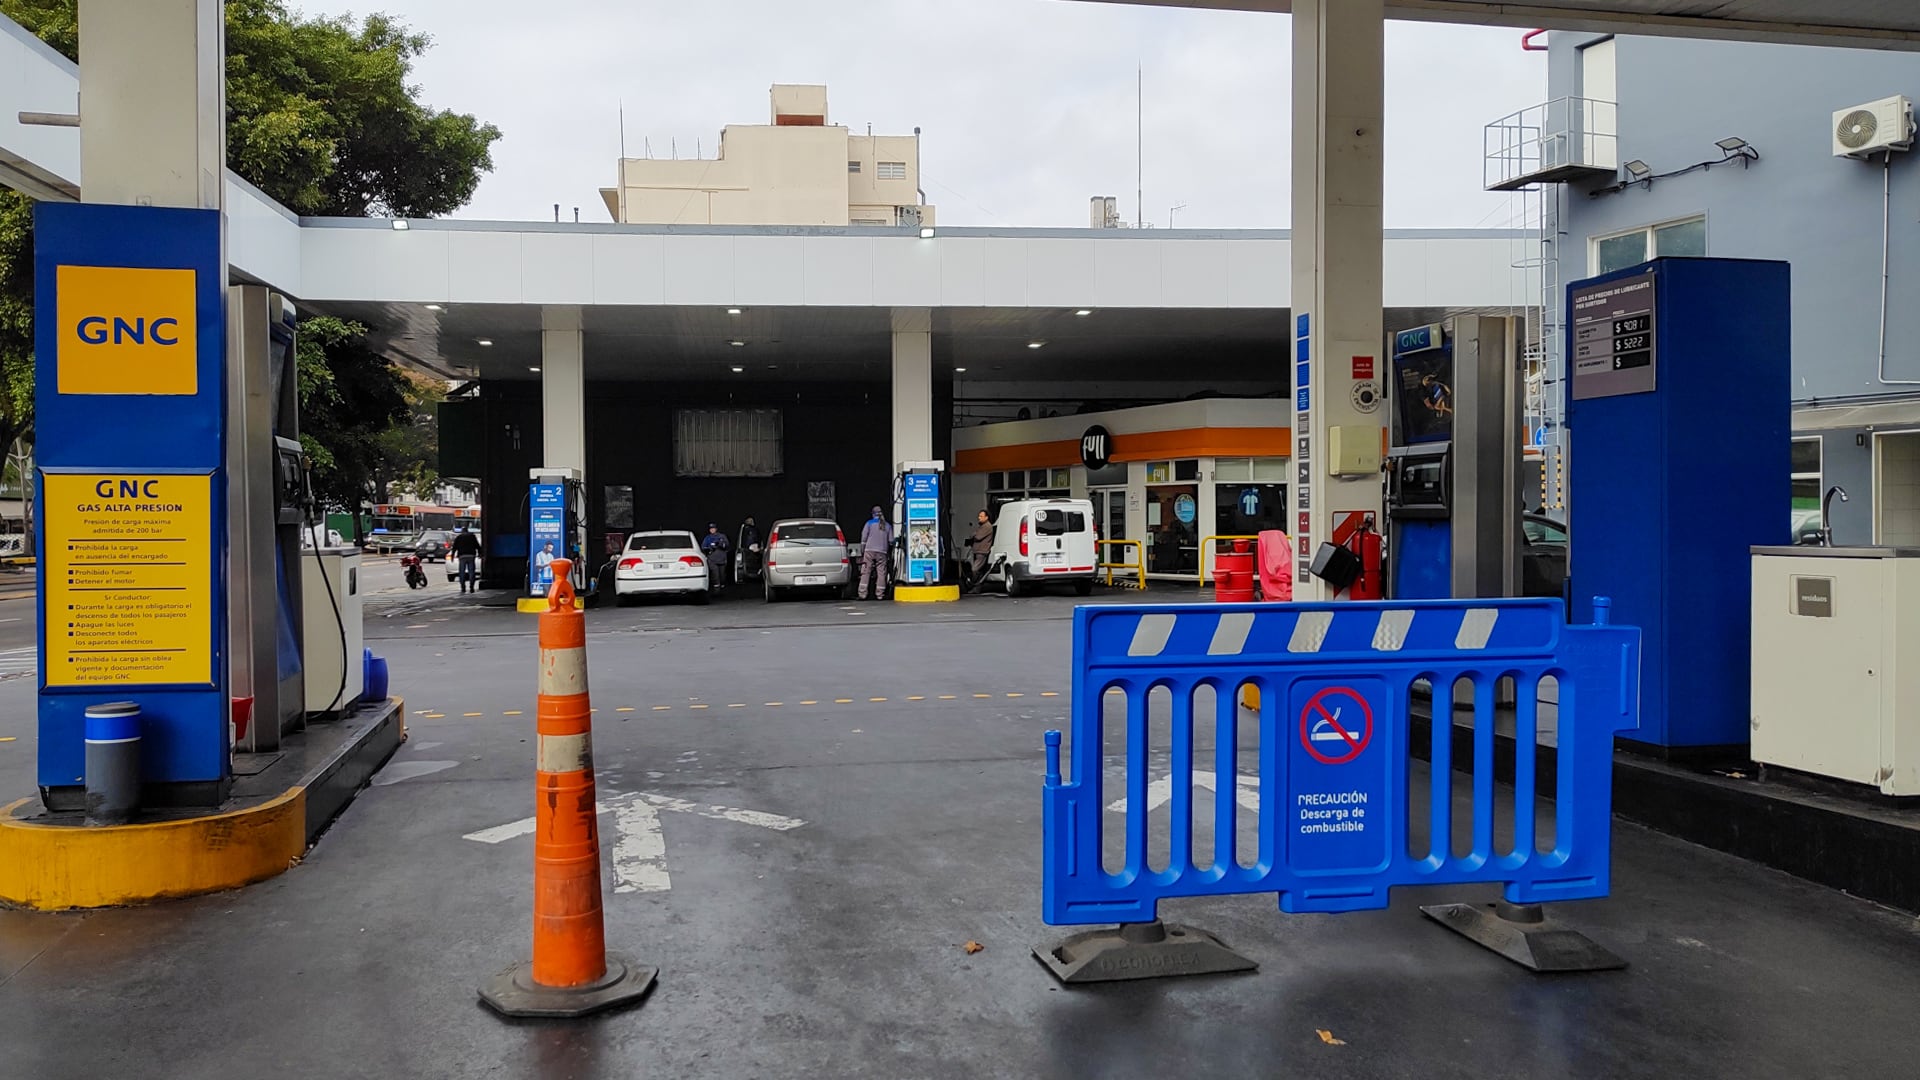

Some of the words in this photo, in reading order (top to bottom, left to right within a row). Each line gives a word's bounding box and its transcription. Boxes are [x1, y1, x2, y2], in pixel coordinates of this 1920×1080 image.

[76, 316, 178, 345] GNC
[1401, 331, 1425, 348] GNC
[1082, 434, 1105, 461] full
[908, 477, 914, 485] 3
[931, 477, 936, 485] 4
[96, 479, 160, 498] GNC
[532, 487, 536, 495] 1
[556, 487, 562, 495] 2
[78, 504, 100, 512] GAS
[135, 504, 183, 512] PRESION
[1298, 790, 1368, 806] PRECAUCIÓN
[1300, 808, 1348, 820] Descarga
[1352, 806, 1365, 818] de
[1300, 820, 1364, 833] combustible
